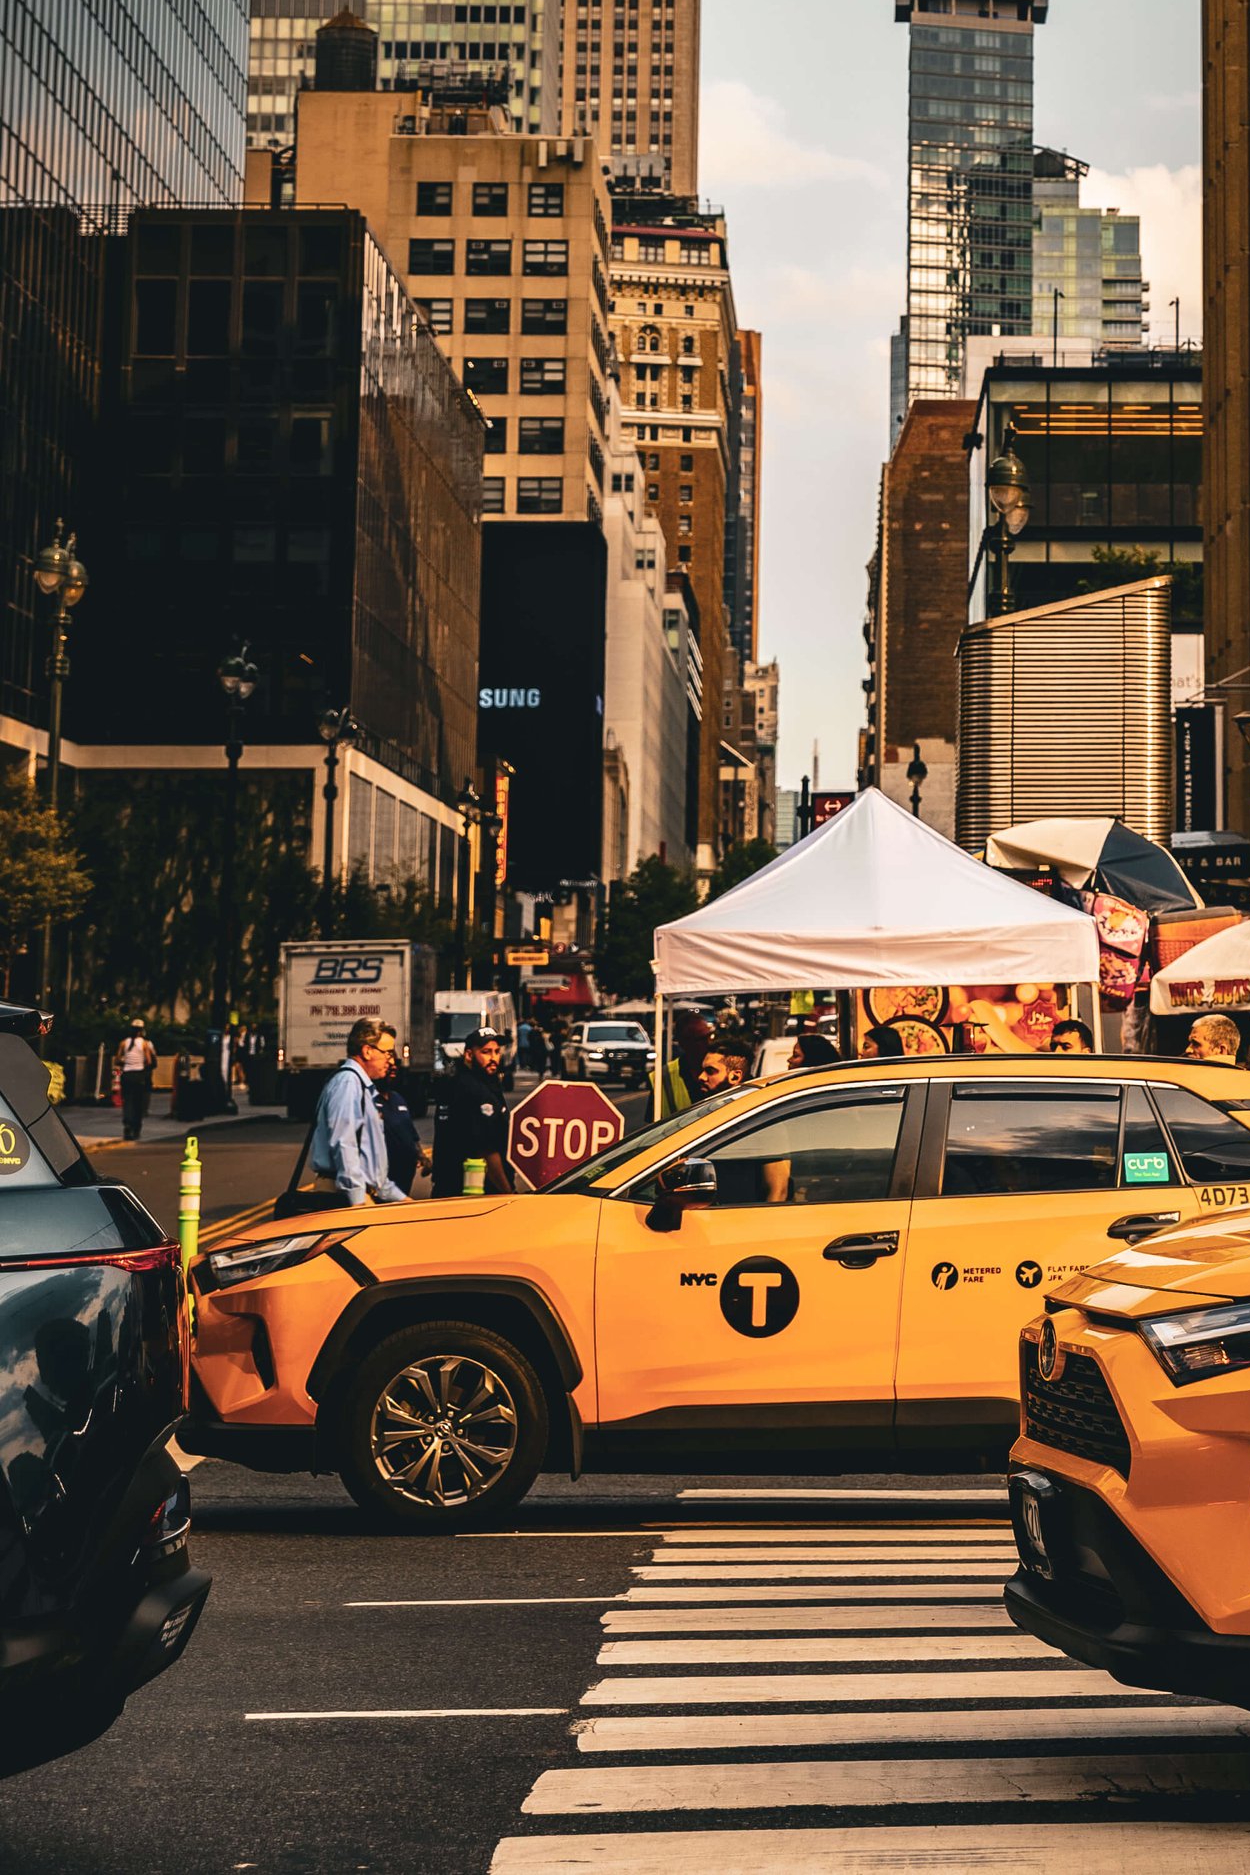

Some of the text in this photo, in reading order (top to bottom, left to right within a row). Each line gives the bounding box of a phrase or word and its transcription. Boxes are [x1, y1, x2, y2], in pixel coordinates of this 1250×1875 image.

[479, 688, 540, 708] SUNG
[1216, 856, 1241, 866] BAR
[309, 957, 384, 985] BRS
[517, 1116, 616, 1160] STOP
[1127, 1157, 1165, 1170] curb
[1201, 1187, 1249, 1206] 4D73
[963, 1267, 1002, 1275] METERED
[680, 1272, 782, 1327] NYC T
